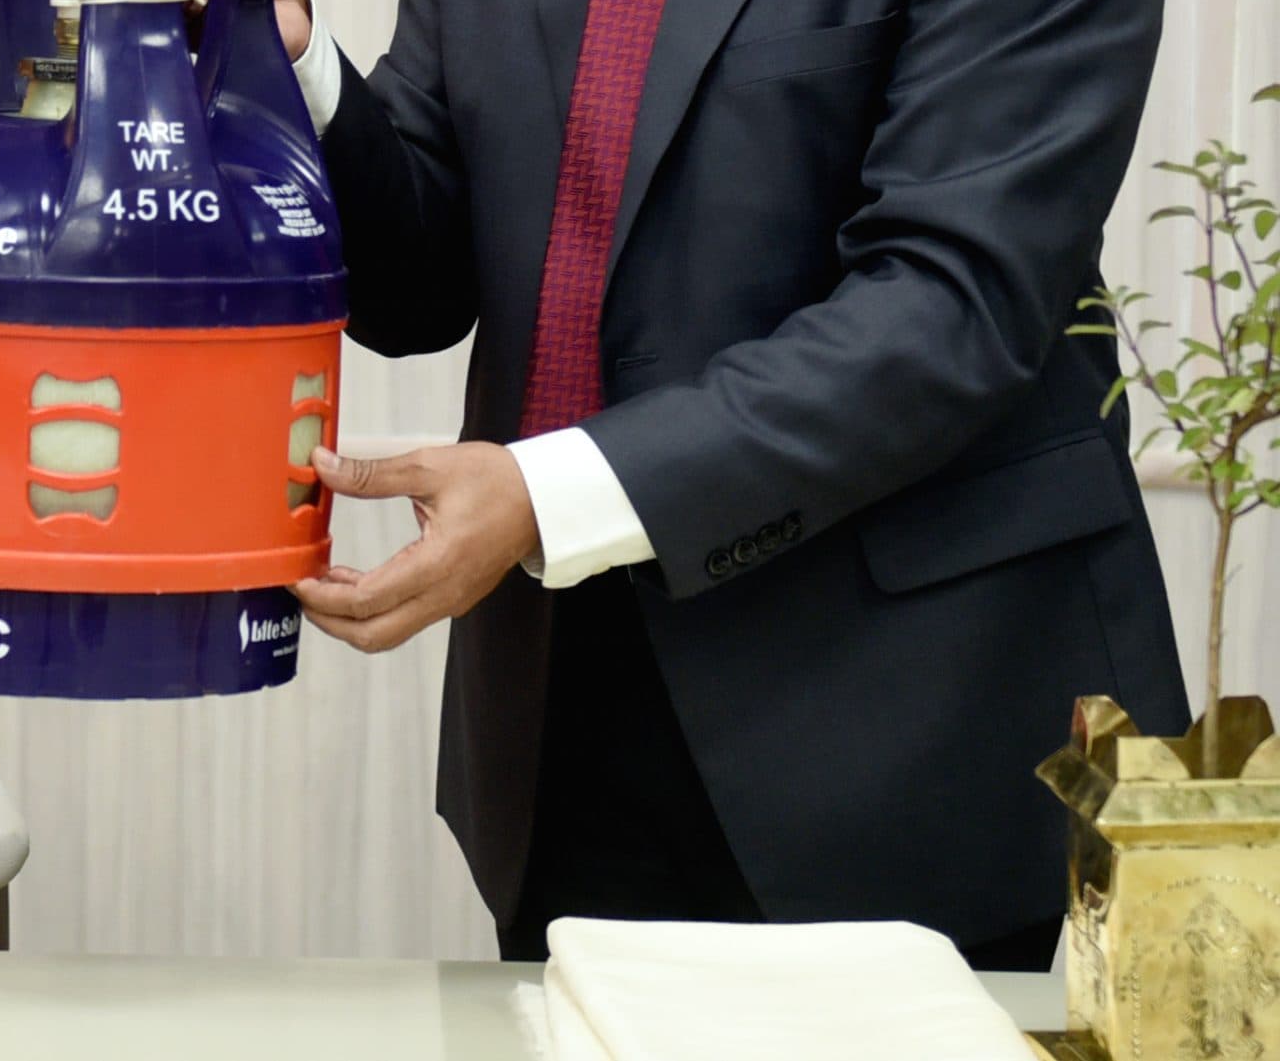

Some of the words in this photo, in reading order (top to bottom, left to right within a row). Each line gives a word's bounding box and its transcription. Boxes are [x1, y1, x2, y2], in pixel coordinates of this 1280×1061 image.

[117, 121, 185, 144] TARE
[131, 149, 179, 172] WT.
[102, 189, 158, 221] 4.5
[167, 189, 221, 222] KG
